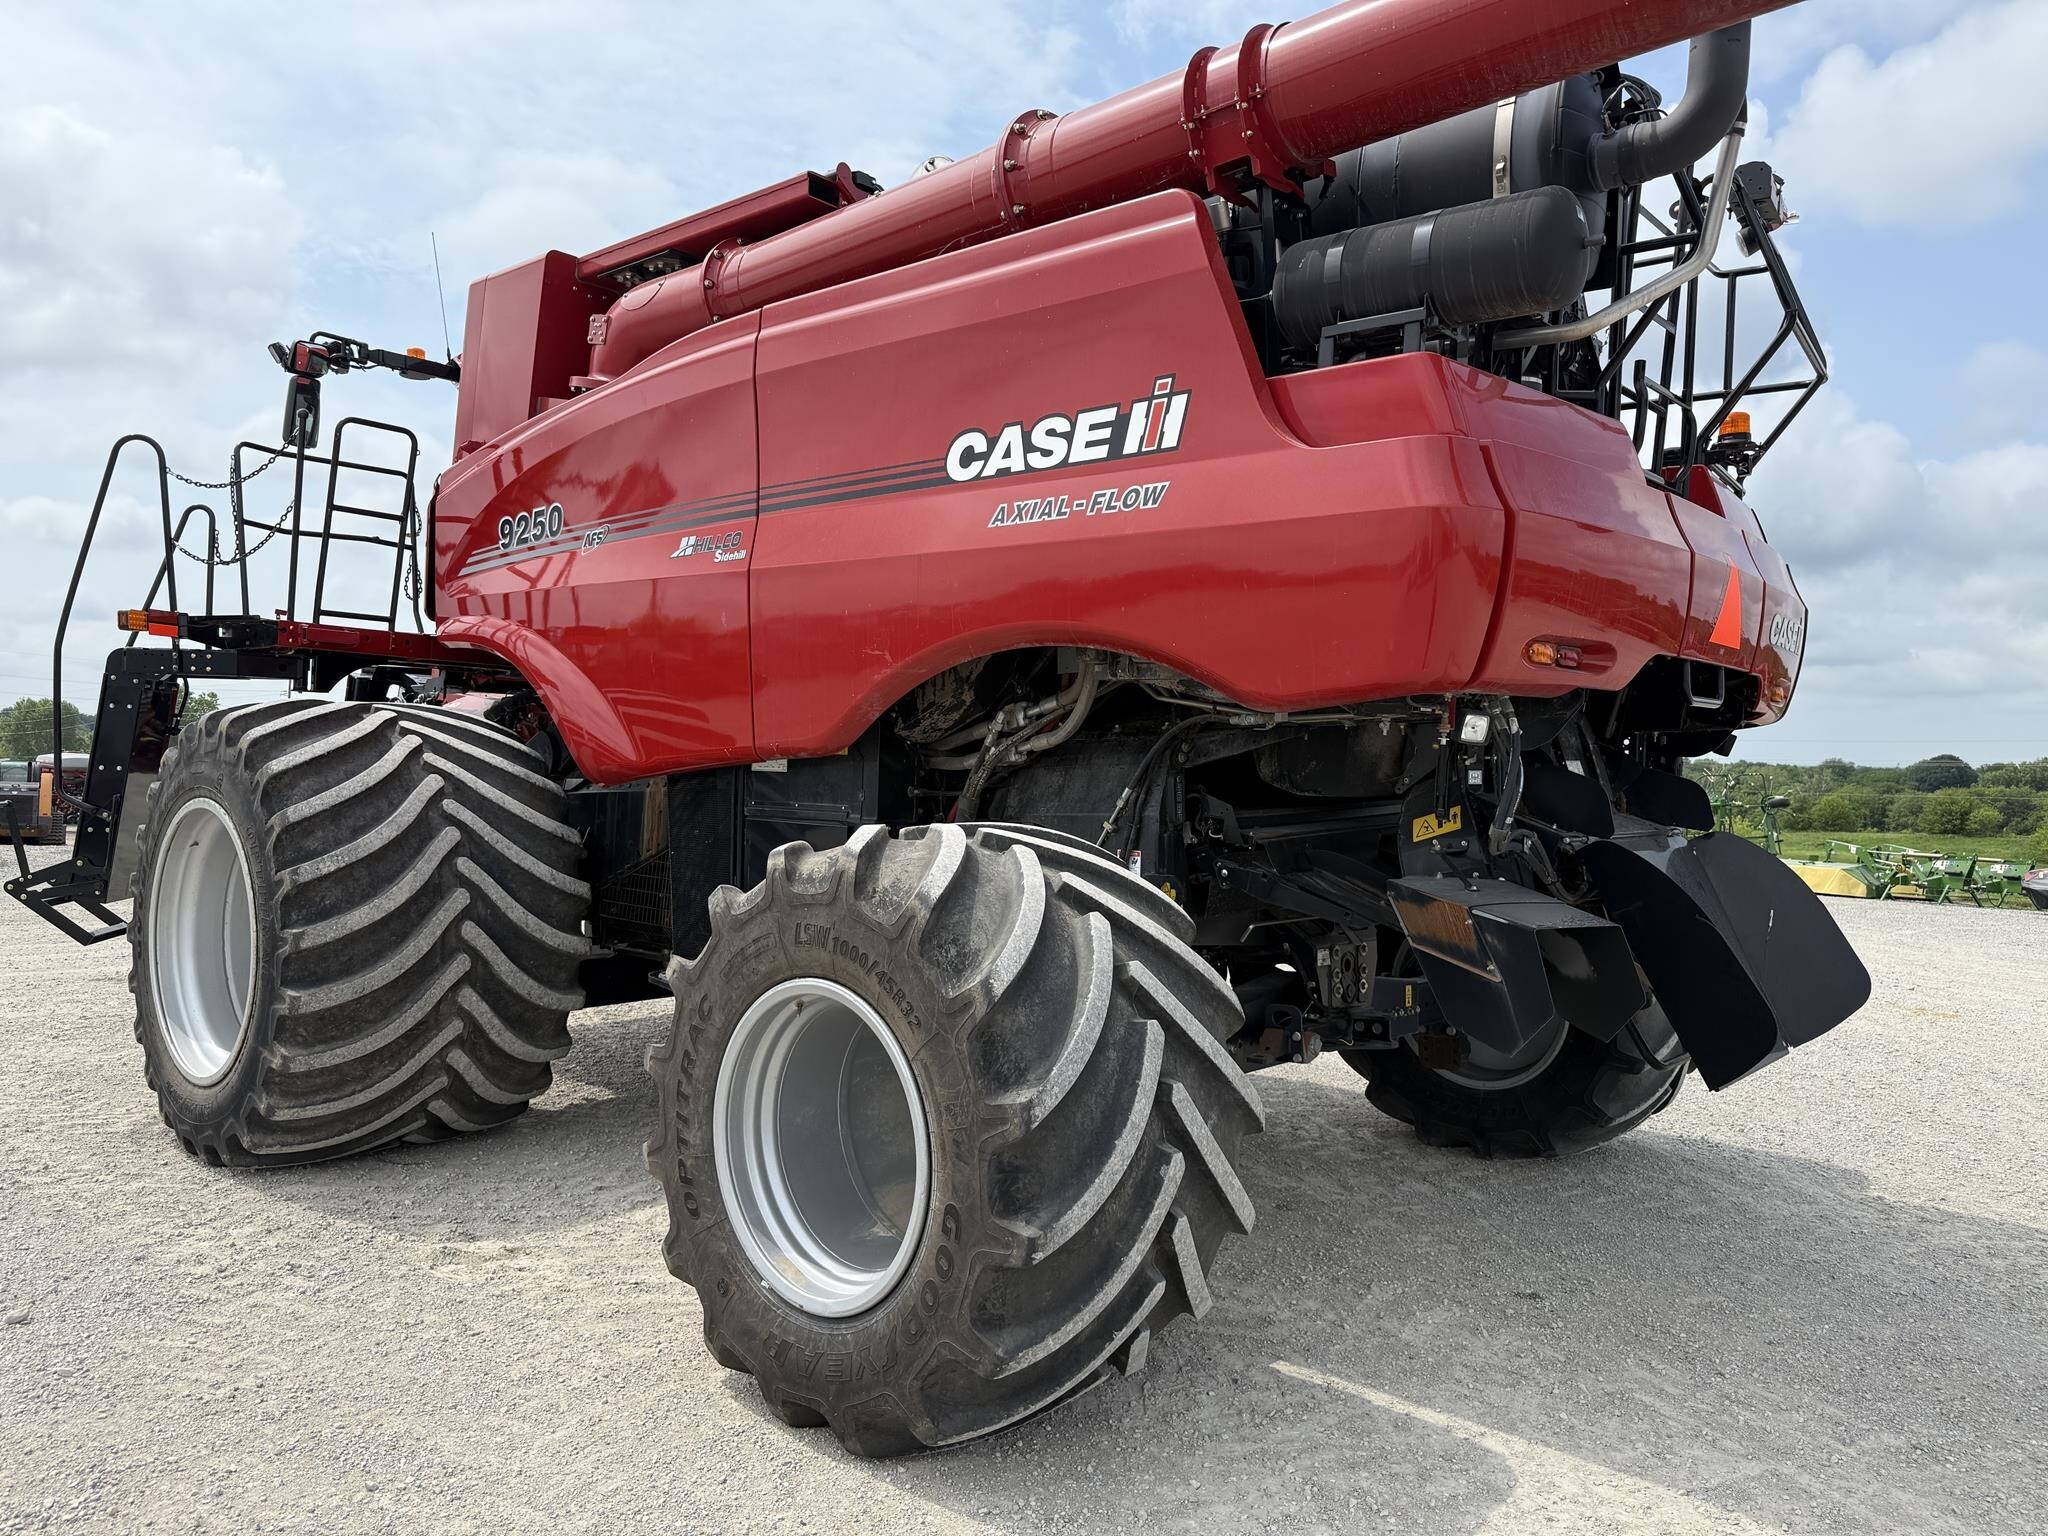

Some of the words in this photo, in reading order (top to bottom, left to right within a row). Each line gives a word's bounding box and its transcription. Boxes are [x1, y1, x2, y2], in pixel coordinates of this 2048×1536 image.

[945, 405, 1118, 482] CASE
[987, 481, 1170, 528] AXIAL-FLOW
[498, 502, 564, 551] 9250
[582, 529, 605, 549] AFS
[693, 531, 743, 554] HILLCO
[713, 549, 747, 563] Sidehill
[1769, 613, 1798, 653] CASE
